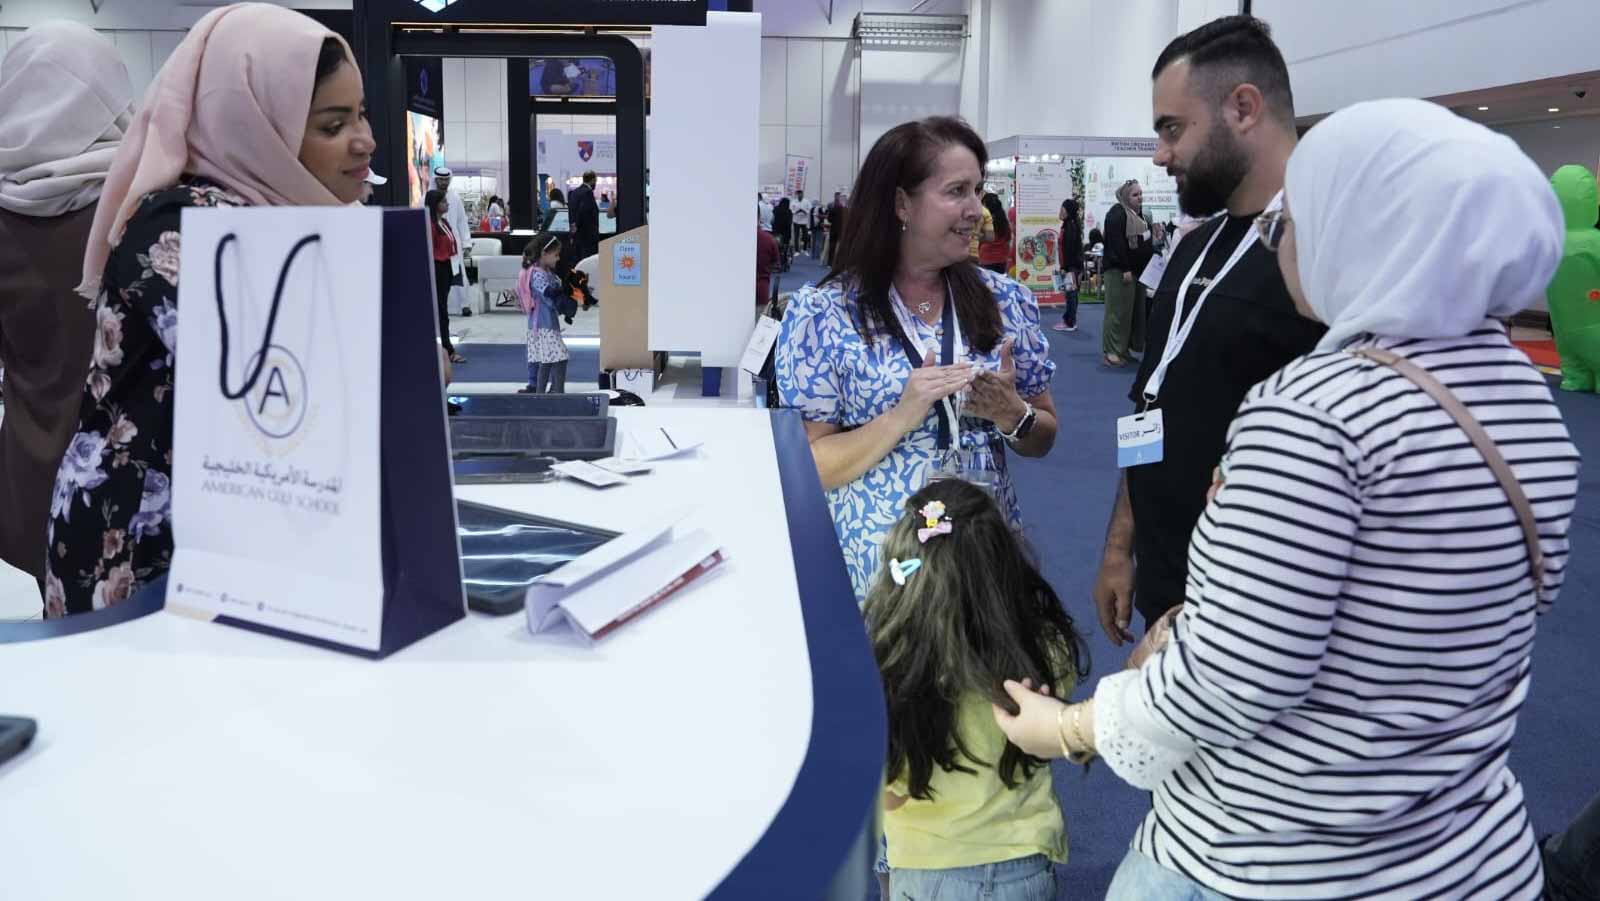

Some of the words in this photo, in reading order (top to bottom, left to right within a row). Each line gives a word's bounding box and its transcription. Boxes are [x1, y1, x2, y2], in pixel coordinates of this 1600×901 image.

[258, 366, 290, 415] A
[1119, 431, 1140, 441] VISITOR
[201, 479, 265, 500] AMERICAN
[297, 495, 341, 516] SCHOOL
